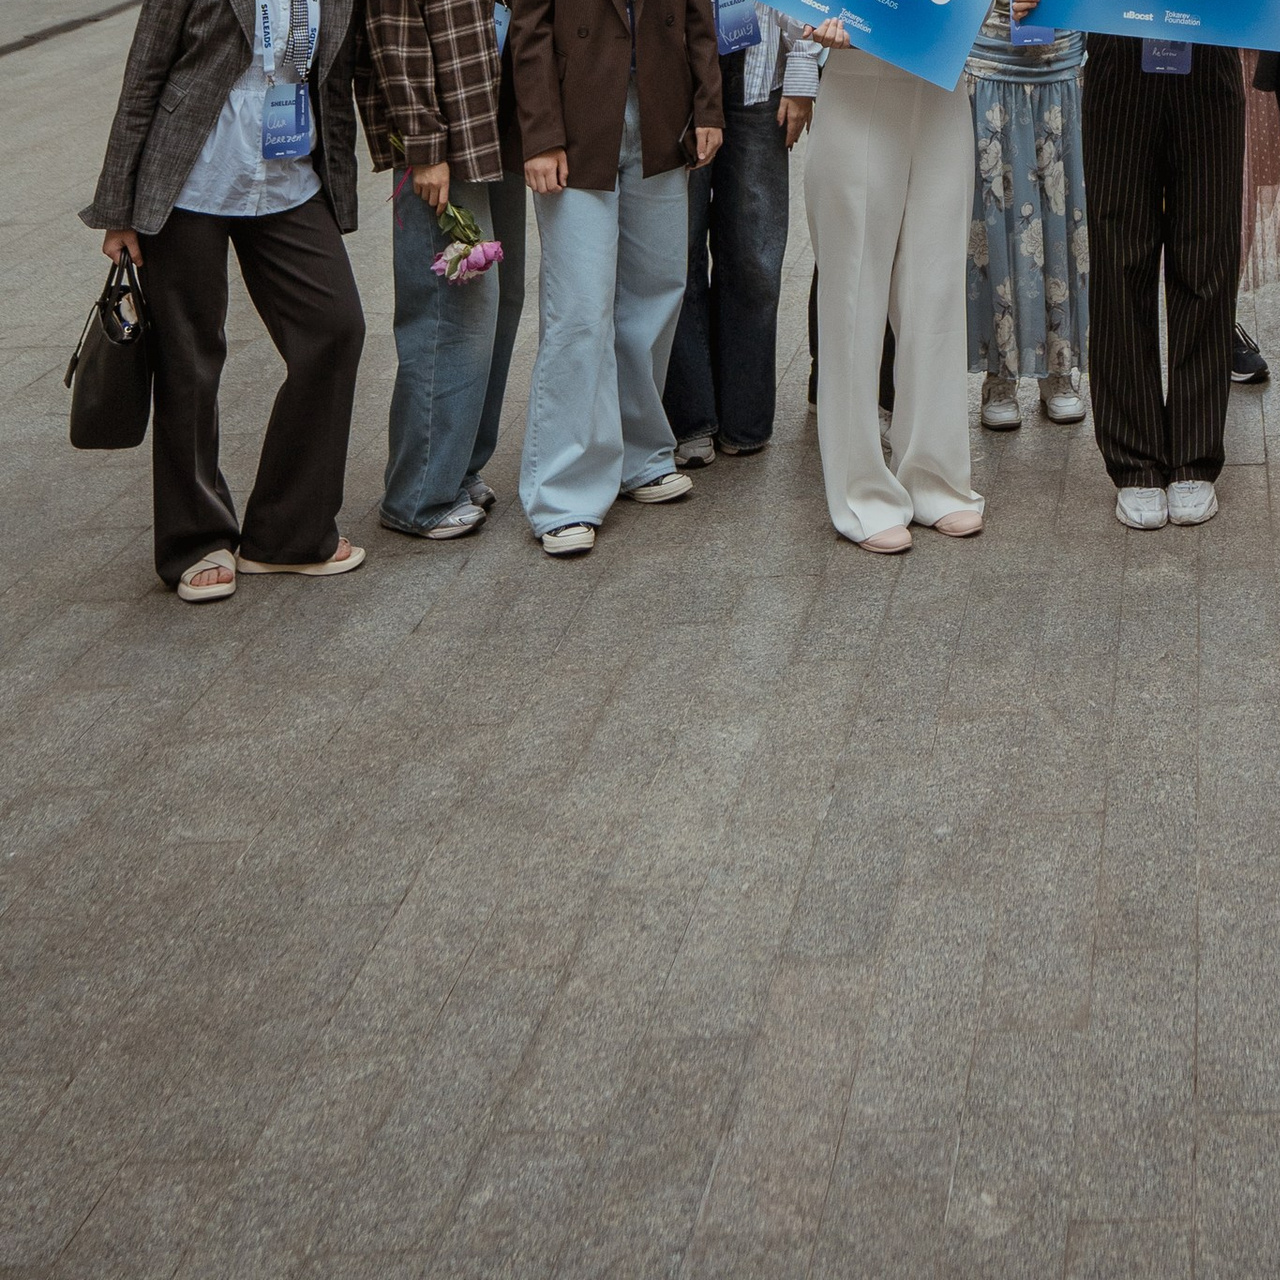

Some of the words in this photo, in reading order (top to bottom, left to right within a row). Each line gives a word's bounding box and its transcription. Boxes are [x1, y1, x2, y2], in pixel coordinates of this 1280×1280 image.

[841, 7, 865, 25] Tokarev
[1123, 10, 1154, 21] uBoost
[1164, 17, 1201, 26] Foundation
[1165, 10, 1191, 20] Tokarev
[261, 4, 272, 49] SHELEADS
[838, 13, 872, 35] Foundation
